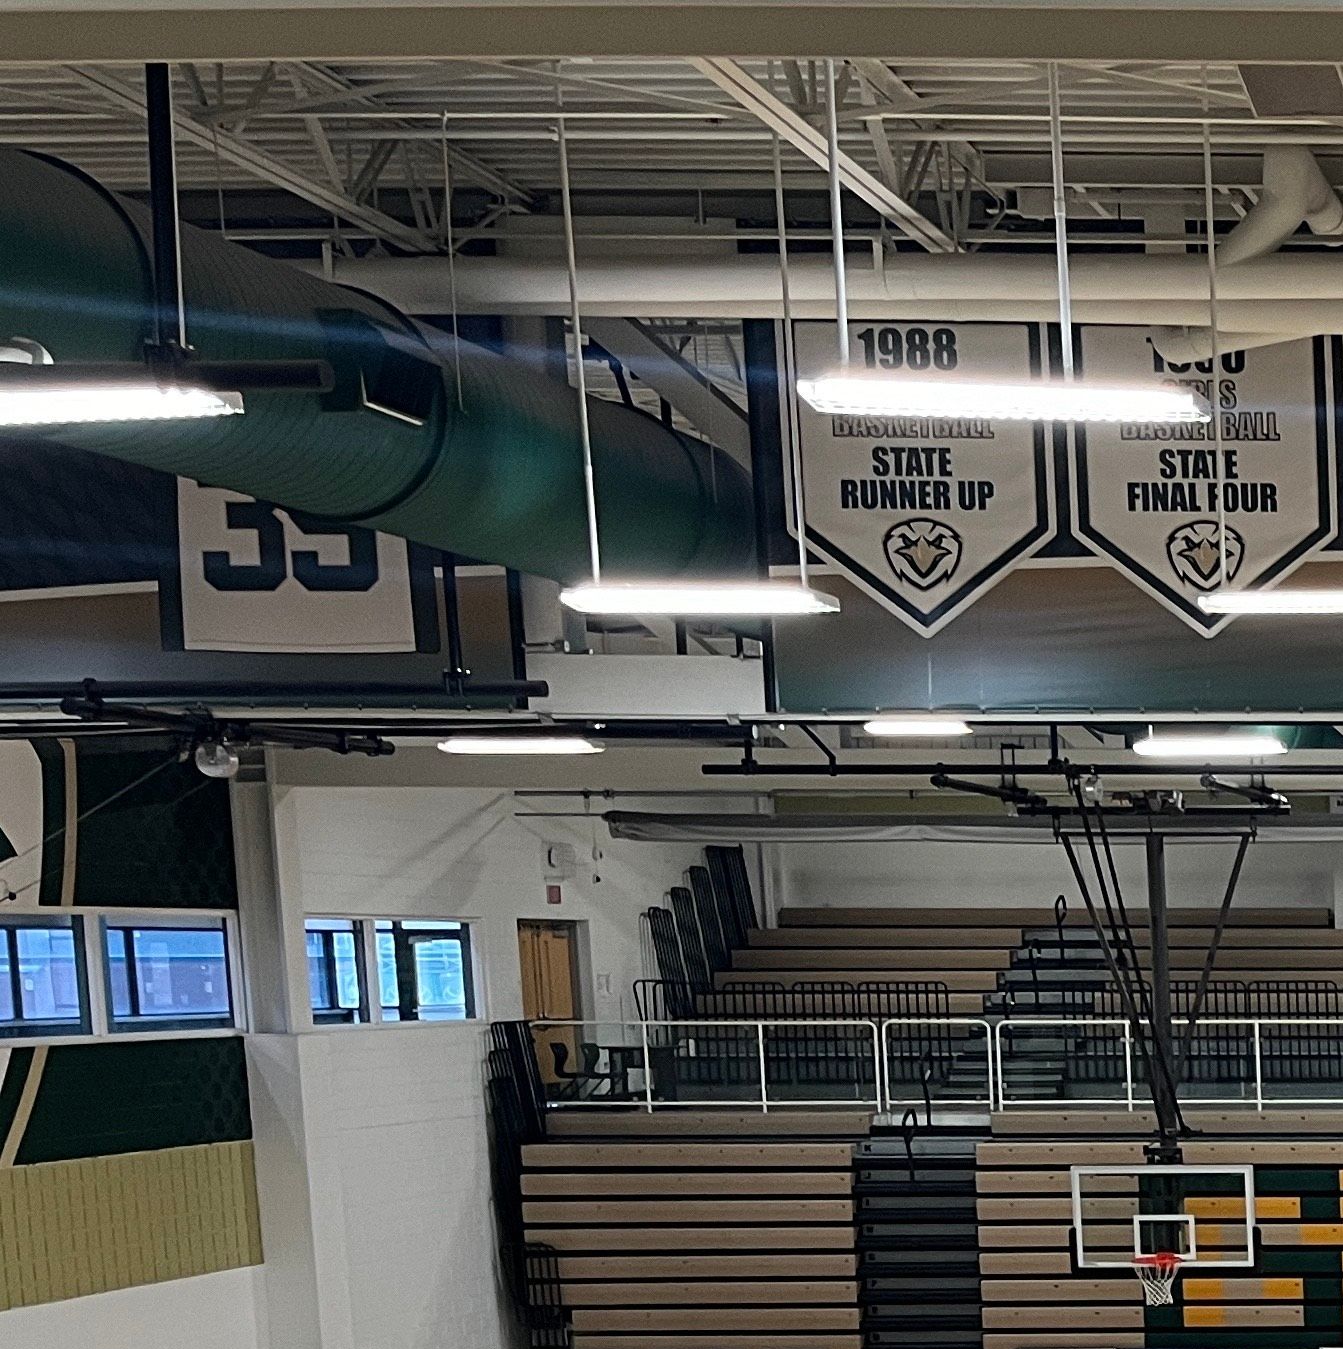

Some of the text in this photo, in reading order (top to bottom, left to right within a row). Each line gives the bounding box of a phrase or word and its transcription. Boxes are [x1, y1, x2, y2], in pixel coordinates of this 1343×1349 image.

[858, 327, 958, 370] 1988
[871, 446, 953, 477] STATE
[841, 479, 995, 510] RUNNER UP
[1127, 482, 1202, 512] FINAL
